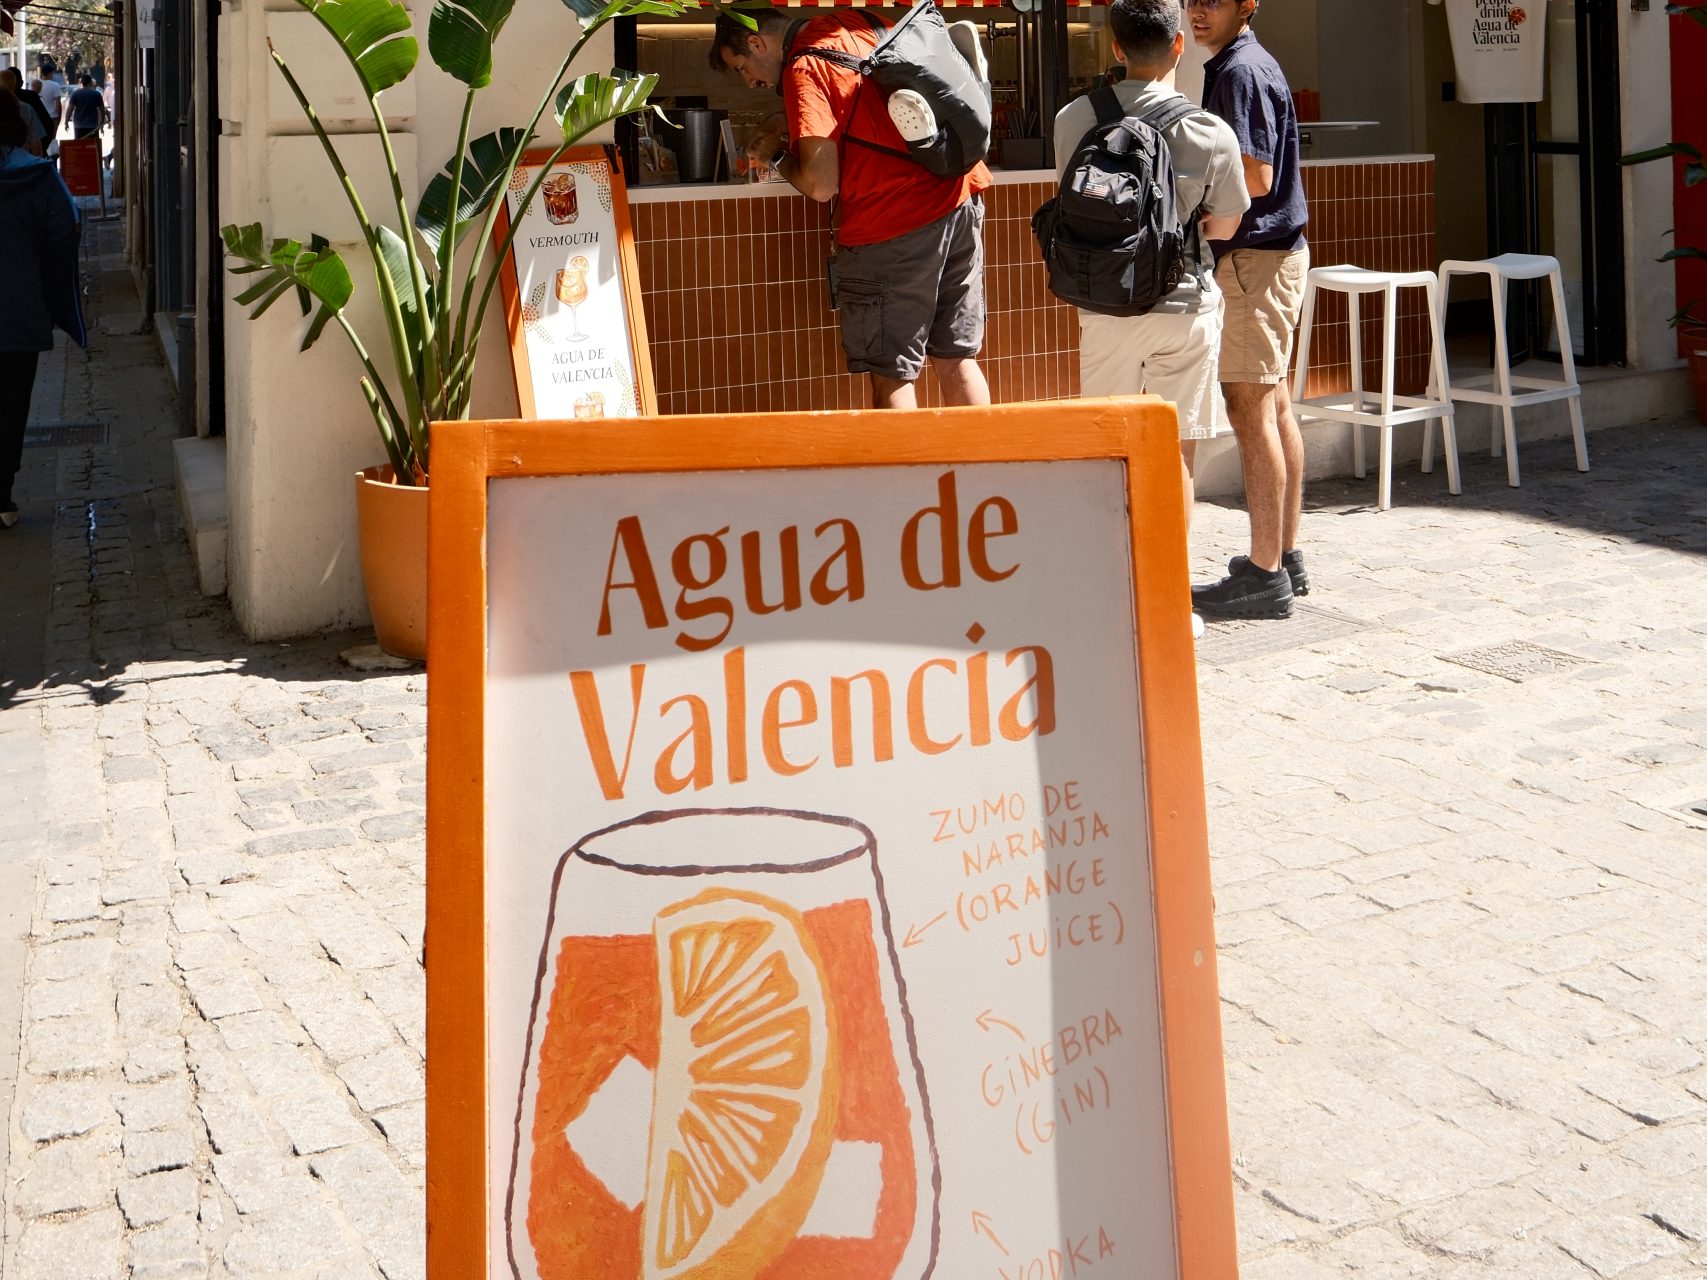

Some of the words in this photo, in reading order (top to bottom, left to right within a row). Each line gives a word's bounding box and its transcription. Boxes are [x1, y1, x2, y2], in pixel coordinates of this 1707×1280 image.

[1472, 31, 1521, 45] Valencia
[1473, 19, 1501, 32] Agua
[529, 231, 600, 249] VERMOUTH
[551, 348, 585, 366] AGUA
[588, 348, 606, 361] DE
[551, 367, 614, 385] VALENCIA
[597, 514, 866, 653] Agua
[901, 470, 1021, 592] de
[568, 621, 1056, 801] Valencia
[928, 791, 1026, 843] ZUMO
[1043, 780, 1082, 817] DE
[962, 811, 1110, 878] NARANJA
[956, 858, 1107, 933] (ORANGE
